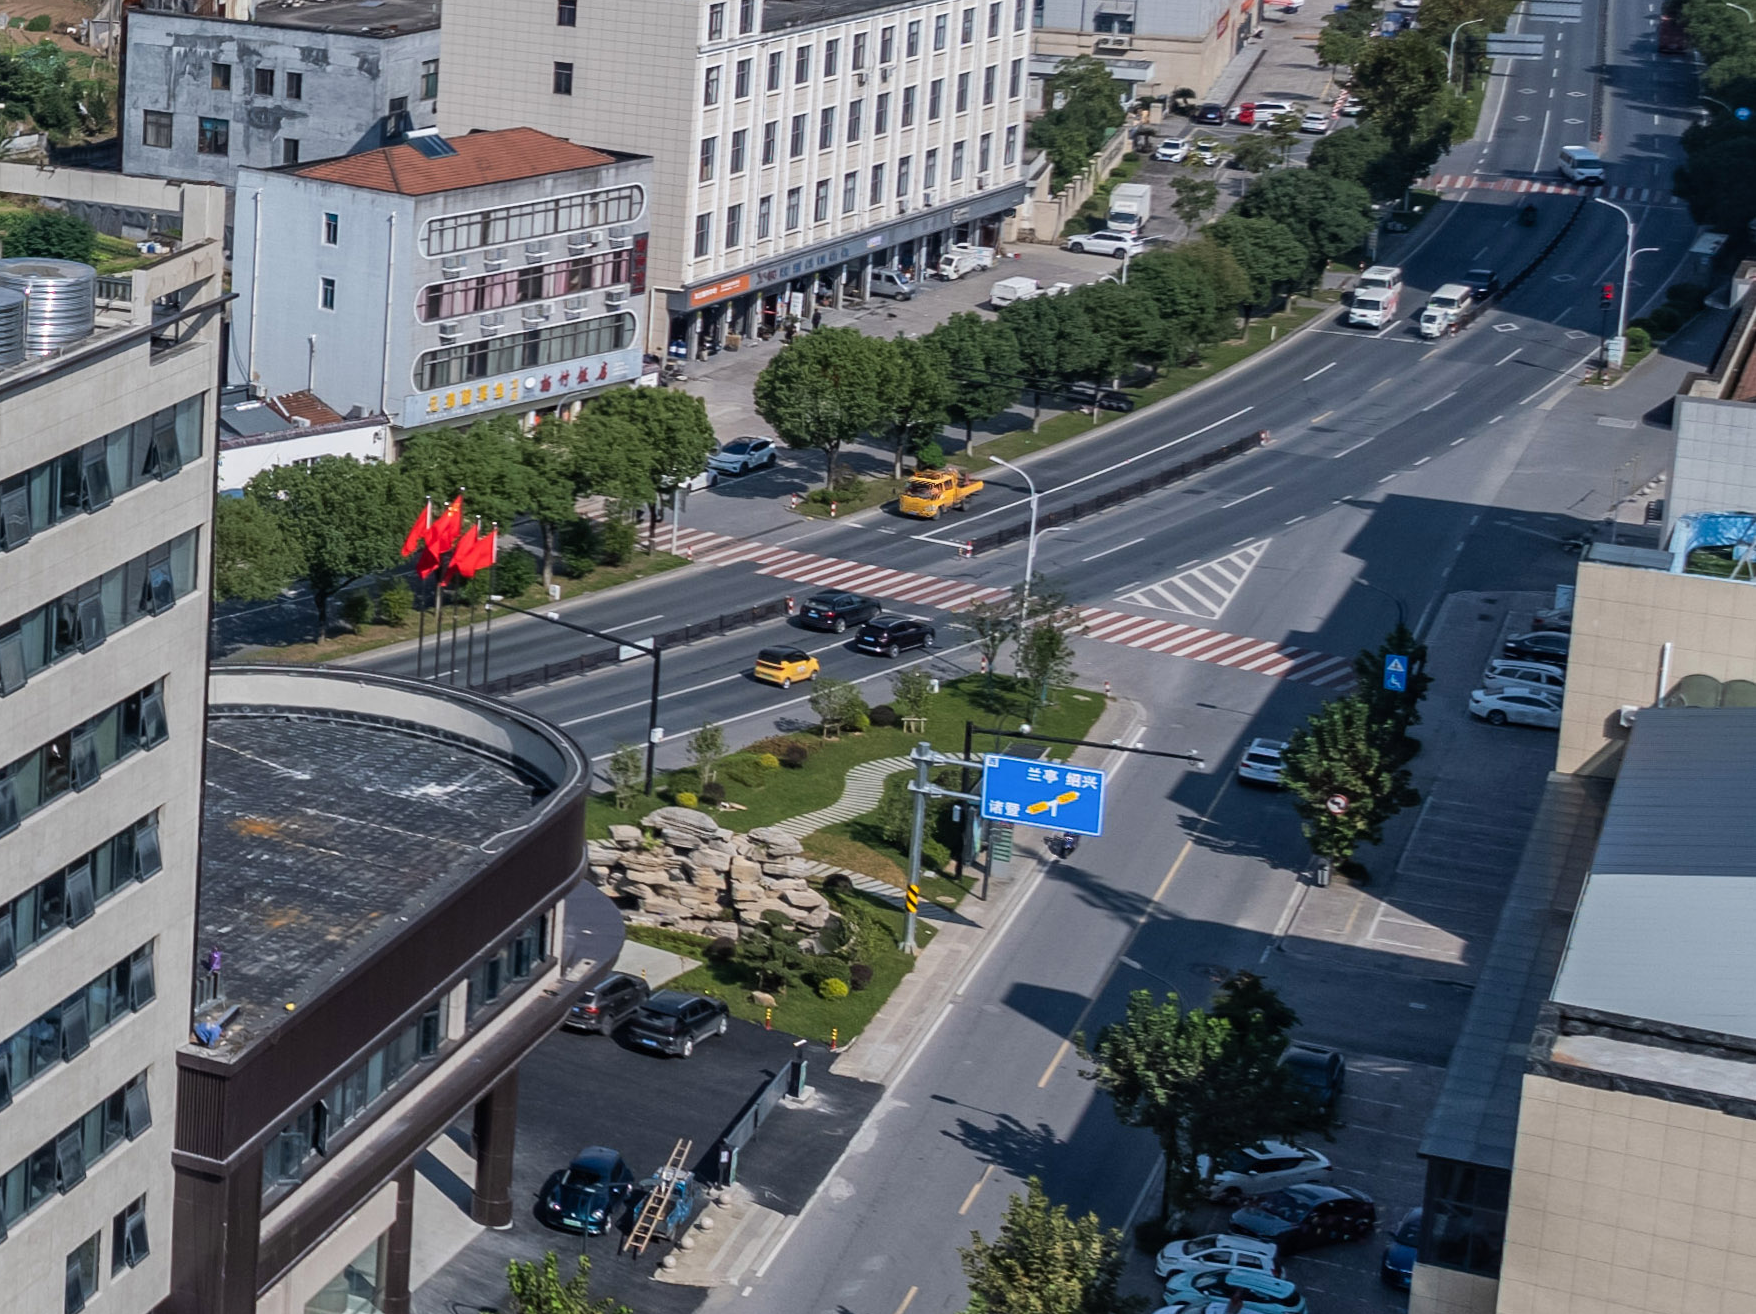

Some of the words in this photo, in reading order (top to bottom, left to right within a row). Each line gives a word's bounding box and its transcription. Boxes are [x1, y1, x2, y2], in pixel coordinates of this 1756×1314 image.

[1026, 767, 1059, 784] 兰亭
[1065, 772, 1098, 790] 绍兴
[989, 799, 1020, 817] 诸暨
